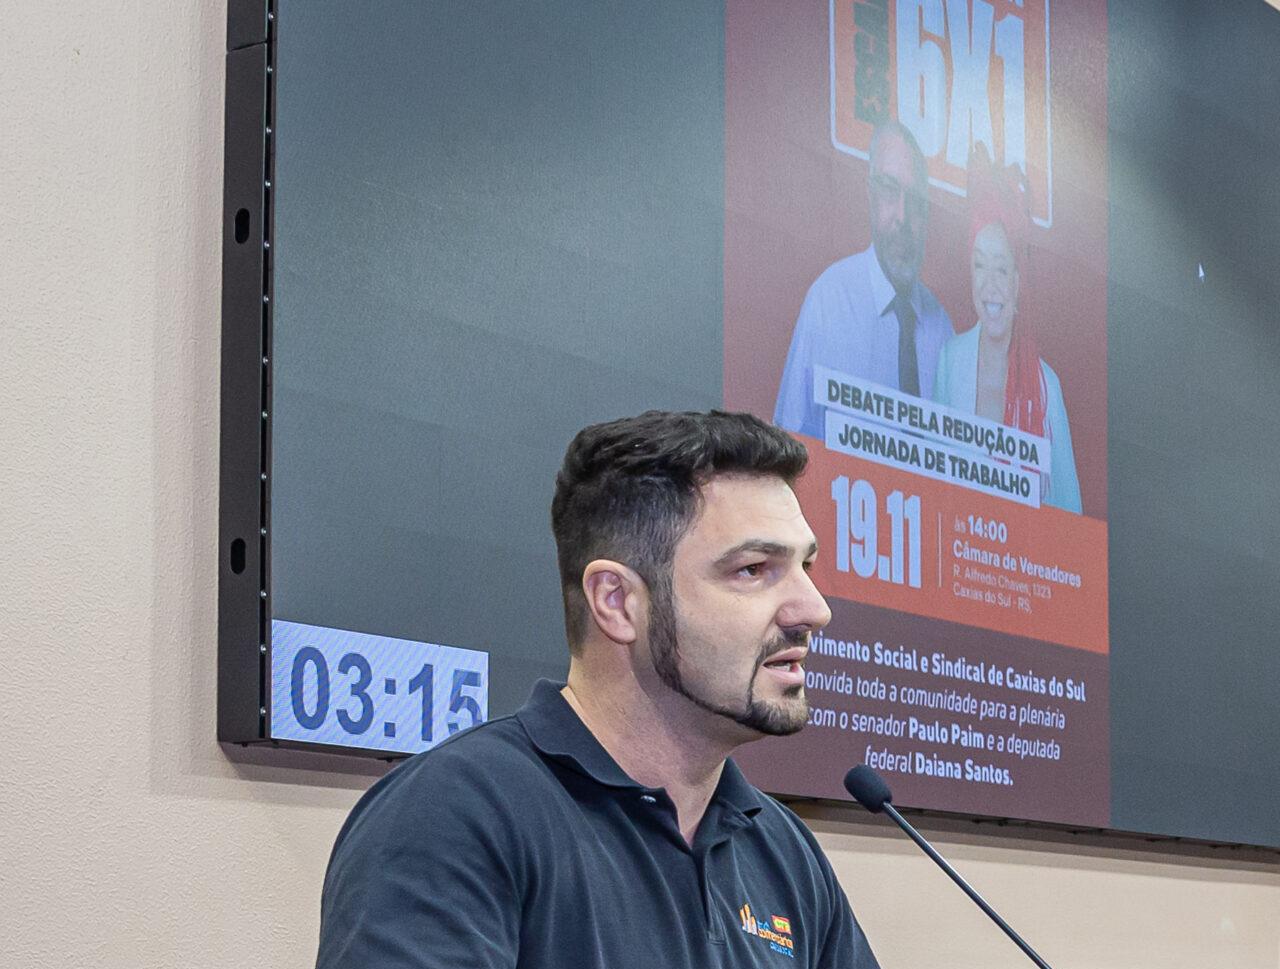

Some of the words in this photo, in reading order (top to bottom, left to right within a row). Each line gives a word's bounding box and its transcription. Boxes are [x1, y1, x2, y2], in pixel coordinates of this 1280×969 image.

[828, 379, 894, 420] DEBATE
[898, 400, 939, 434] PELA
[943, 415, 1016, 456] REDUÇÃO
[1019, 439, 1039, 465] DA
[839, 424, 921, 467] JORNADA
[924, 447, 945, 474] DE
[948, 454, 1030, 498] TRABALHO
[831, 474, 921, 588] 19.11
[968, 514, 1008, 543] 14:00
[953, 539, 1000, 567] Câmara
[1002, 552, 1017, 571] de
[1020, 556, 1082, 588] Vereadores
[965, 566, 996, 587] Alfredo
[953, 582, 983, 601] Caxias
[985, 591, 996, 604] do
[998, 592, 1012, 608] Sul
[810, 631, 870, 662] vimento
[874, 642, 918, 671] Social
[920, 656, 928, 673] e
[932, 653, 985, 684] Sindical
[988, 664, 1003, 686] de
[1006, 667, 1045, 695] Caxias
[1049, 676, 1063, 697] do
[1066, 678, 1086, 702] Sul
[291, 646, 482, 742] 03:15
[806, 670, 852, 695] onvida
[856, 677, 886, 700] toda
[889, 685, 897, 702] a
[901, 686, 977, 714] comunidade
[980, 700, 1007, 720] para
[1009, 704, 1016, 721] a
[1019, 703, 1065, 729] plenária
[840, 712, 848, 729] o
[852, 713, 907, 737] senador
[909, 717, 948, 743] Paulo
[951, 723, 984, 748] Paim
[987, 733, 994, 750] e
[997, 735, 1004, 752] a
[1007, 733, 1060, 760] deputada
[865, 745, 912, 774] federal
[915, 752, 962, 779] Daiana
[965, 759, 1013, 786] Santos.
